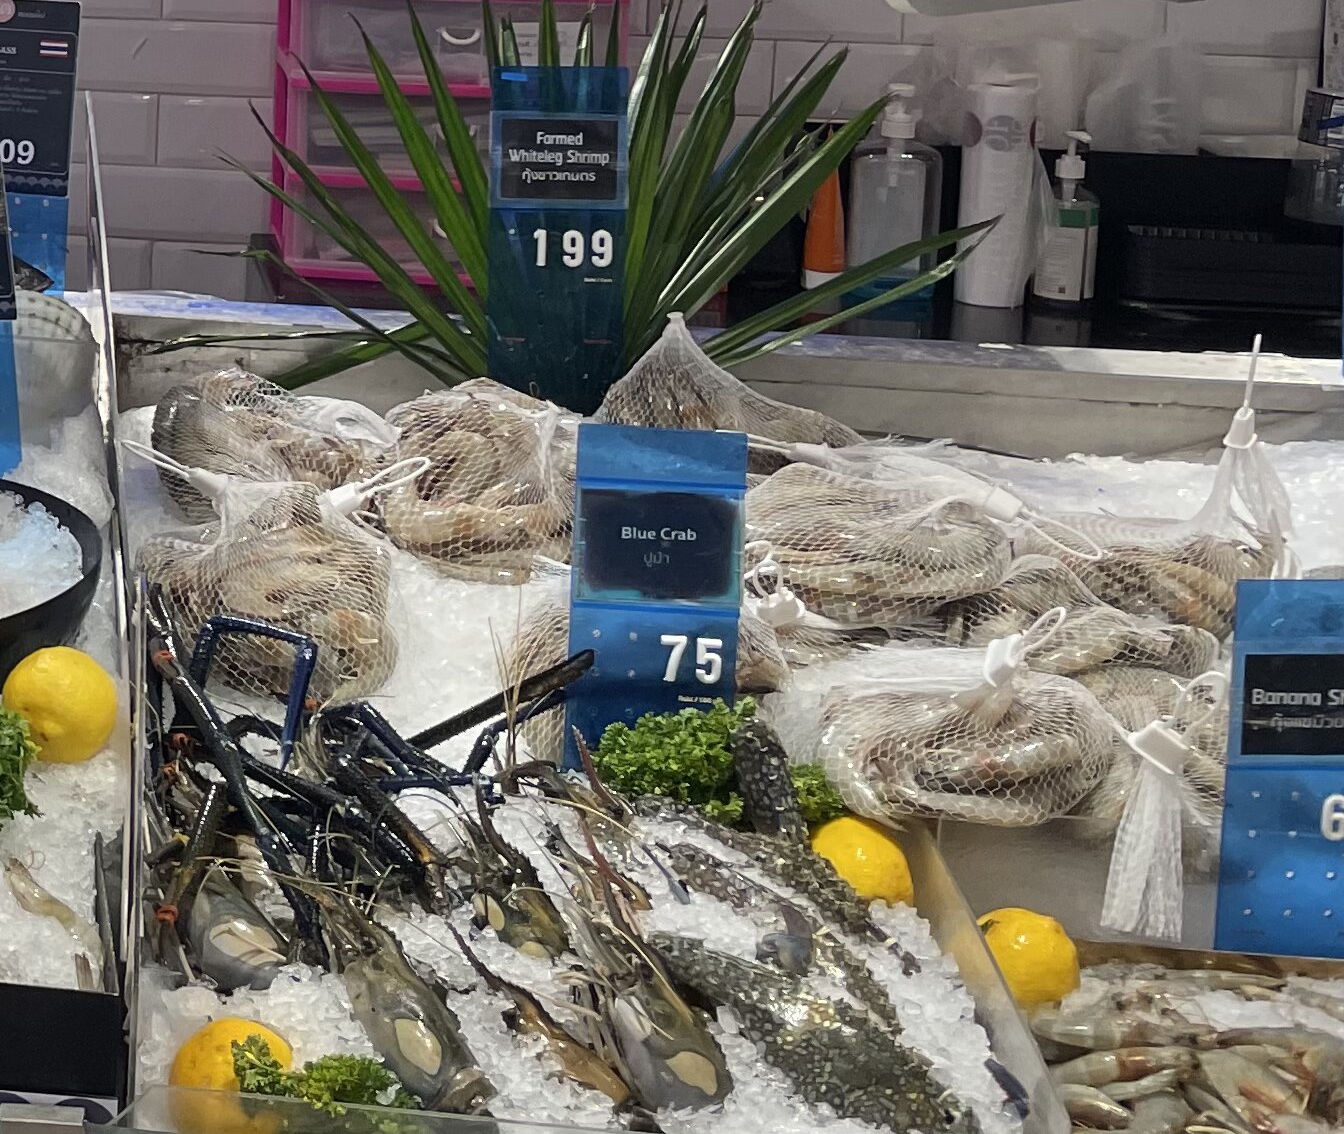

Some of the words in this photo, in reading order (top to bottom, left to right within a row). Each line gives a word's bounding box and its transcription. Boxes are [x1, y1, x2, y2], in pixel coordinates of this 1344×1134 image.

[536, 131, 584, 145] Farmed
[0, 138, 36, 165] 09
[508, 149, 563, 166] Whiteleg
[566, 150, 610, 167] Shrimp
[533, 228, 613, 268] 199
[621, 526, 657, 540] Blue
[660, 527, 697, 541] Crab
[660, 634, 723, 685] 75
[1251, 688, 1321, 706] Banana
[1320, 793, 1344, 842] 6
